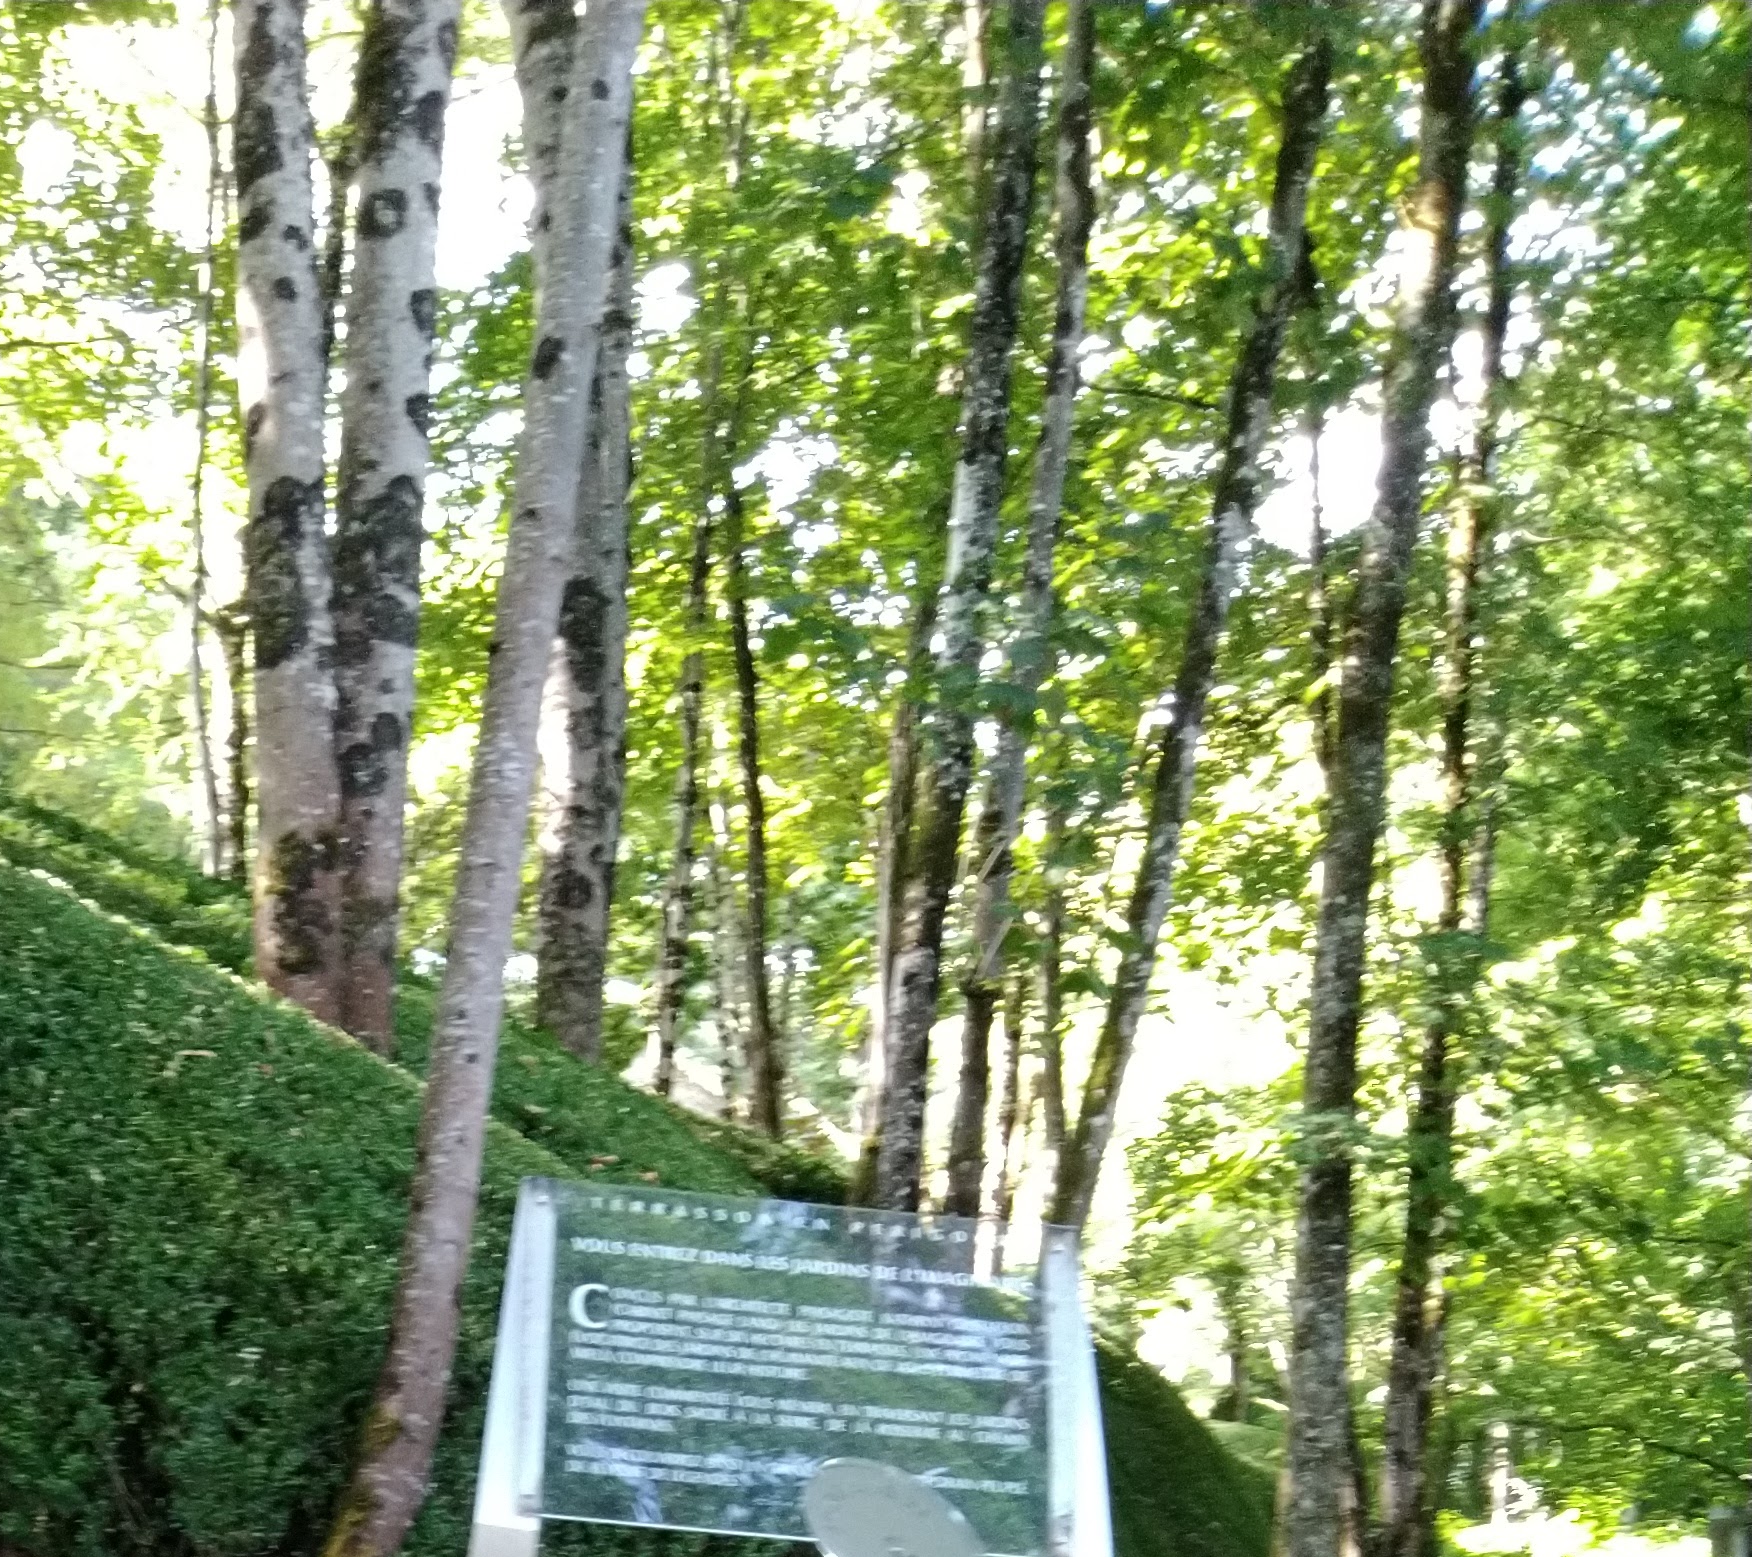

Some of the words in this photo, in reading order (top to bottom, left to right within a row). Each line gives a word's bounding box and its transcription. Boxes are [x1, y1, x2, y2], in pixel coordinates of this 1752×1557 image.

[570, 1236, 625, 1255] VOUS
[626, 1242, 698, 1262] ENTREZ
[699, 1250, 754, 1268] DANS
[754, 1255, 789, 1271] LES
[789, 1258, 871, 1278] JARDINS
[872, 1264, 899, 1280] DE
